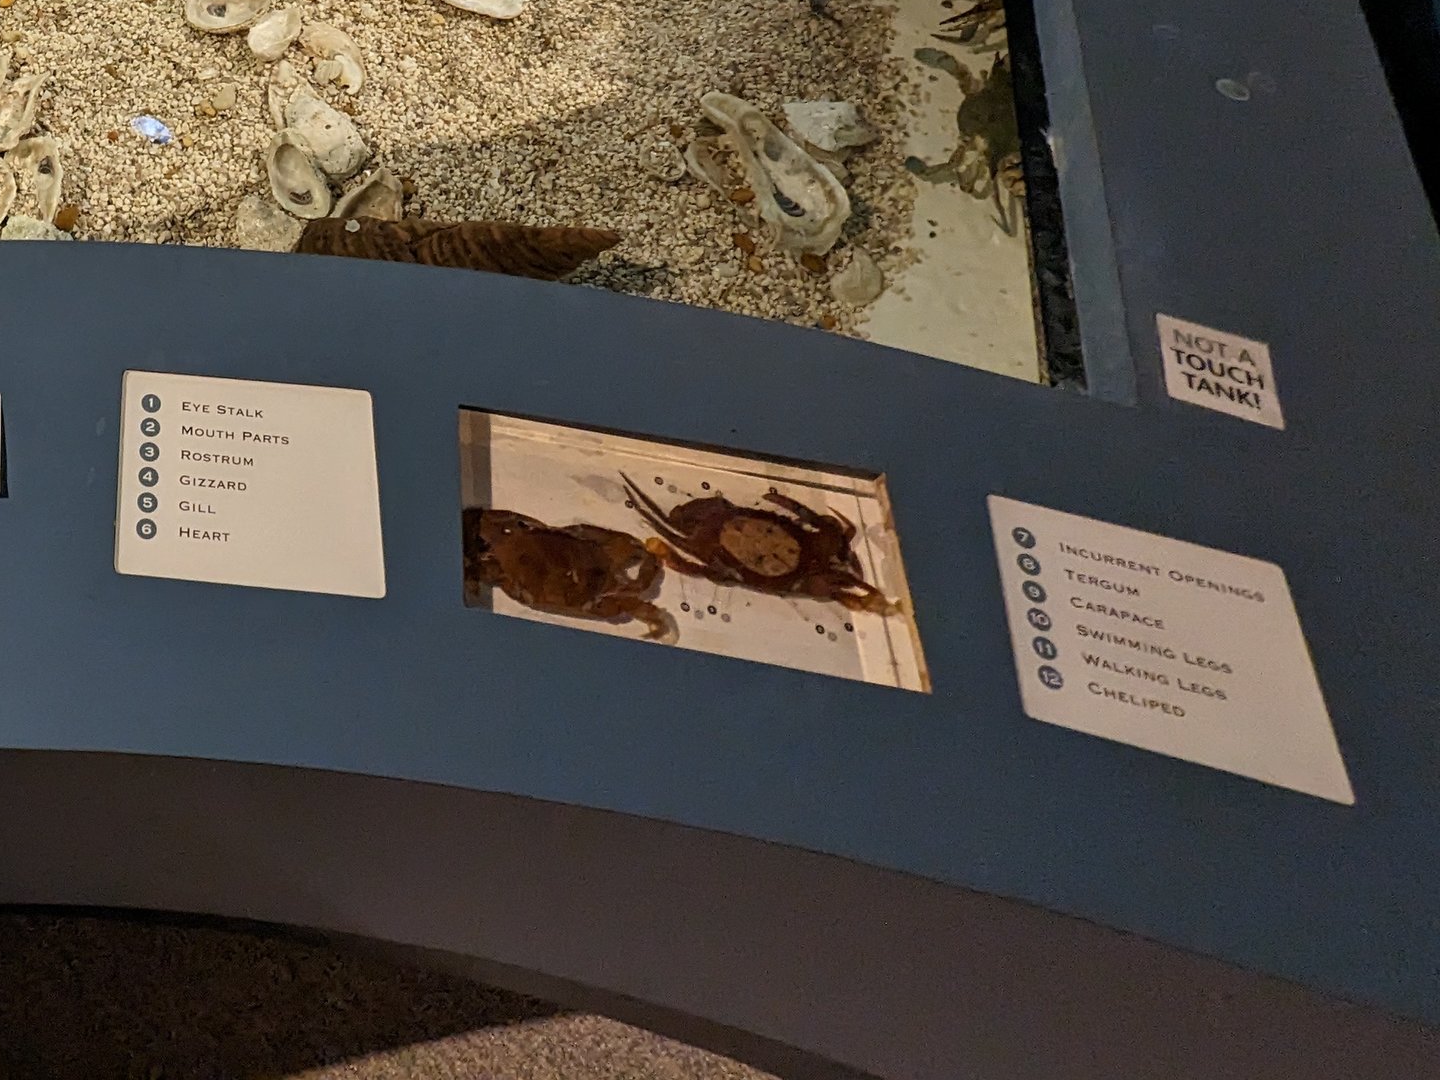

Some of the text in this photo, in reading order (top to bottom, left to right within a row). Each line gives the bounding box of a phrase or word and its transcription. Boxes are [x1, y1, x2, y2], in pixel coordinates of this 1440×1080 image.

[1172, 328, 1256, 368] NOT A
[1169, 346, 1265, 390] TOUCH
[1181, 371, 1262, 410] TANK!
[181, 401, 211, 414] EYE
[216, 404, 264, 419] STALK
[181, 425, 235, 440] MOUTH
[242, 431, 290, 445] PARTS
[181, 449, 254, 467] ROSTRUM
[179, 474, 248, 492] GIZZARD
[178, 500, 217, 515] GILL
[178, 526, 230, 543] HEART
[1059, 542, 1162, 577] INCURRENT
[1168, 570, 1265, 603] OPENINGS
[1064, 568, 1140, 597] TERGUM
[1070, 596, 1165, 630] CARAPACE
[1076, 624, 1177, 660] SWIMMING
[1182, 651, 1233, 674] LEGS
[1081, 651, 1170, 686] WALKING
[1176, 677, 1228, 700] LEGS
[1087, 680, 1187, 718] CHELIPED
